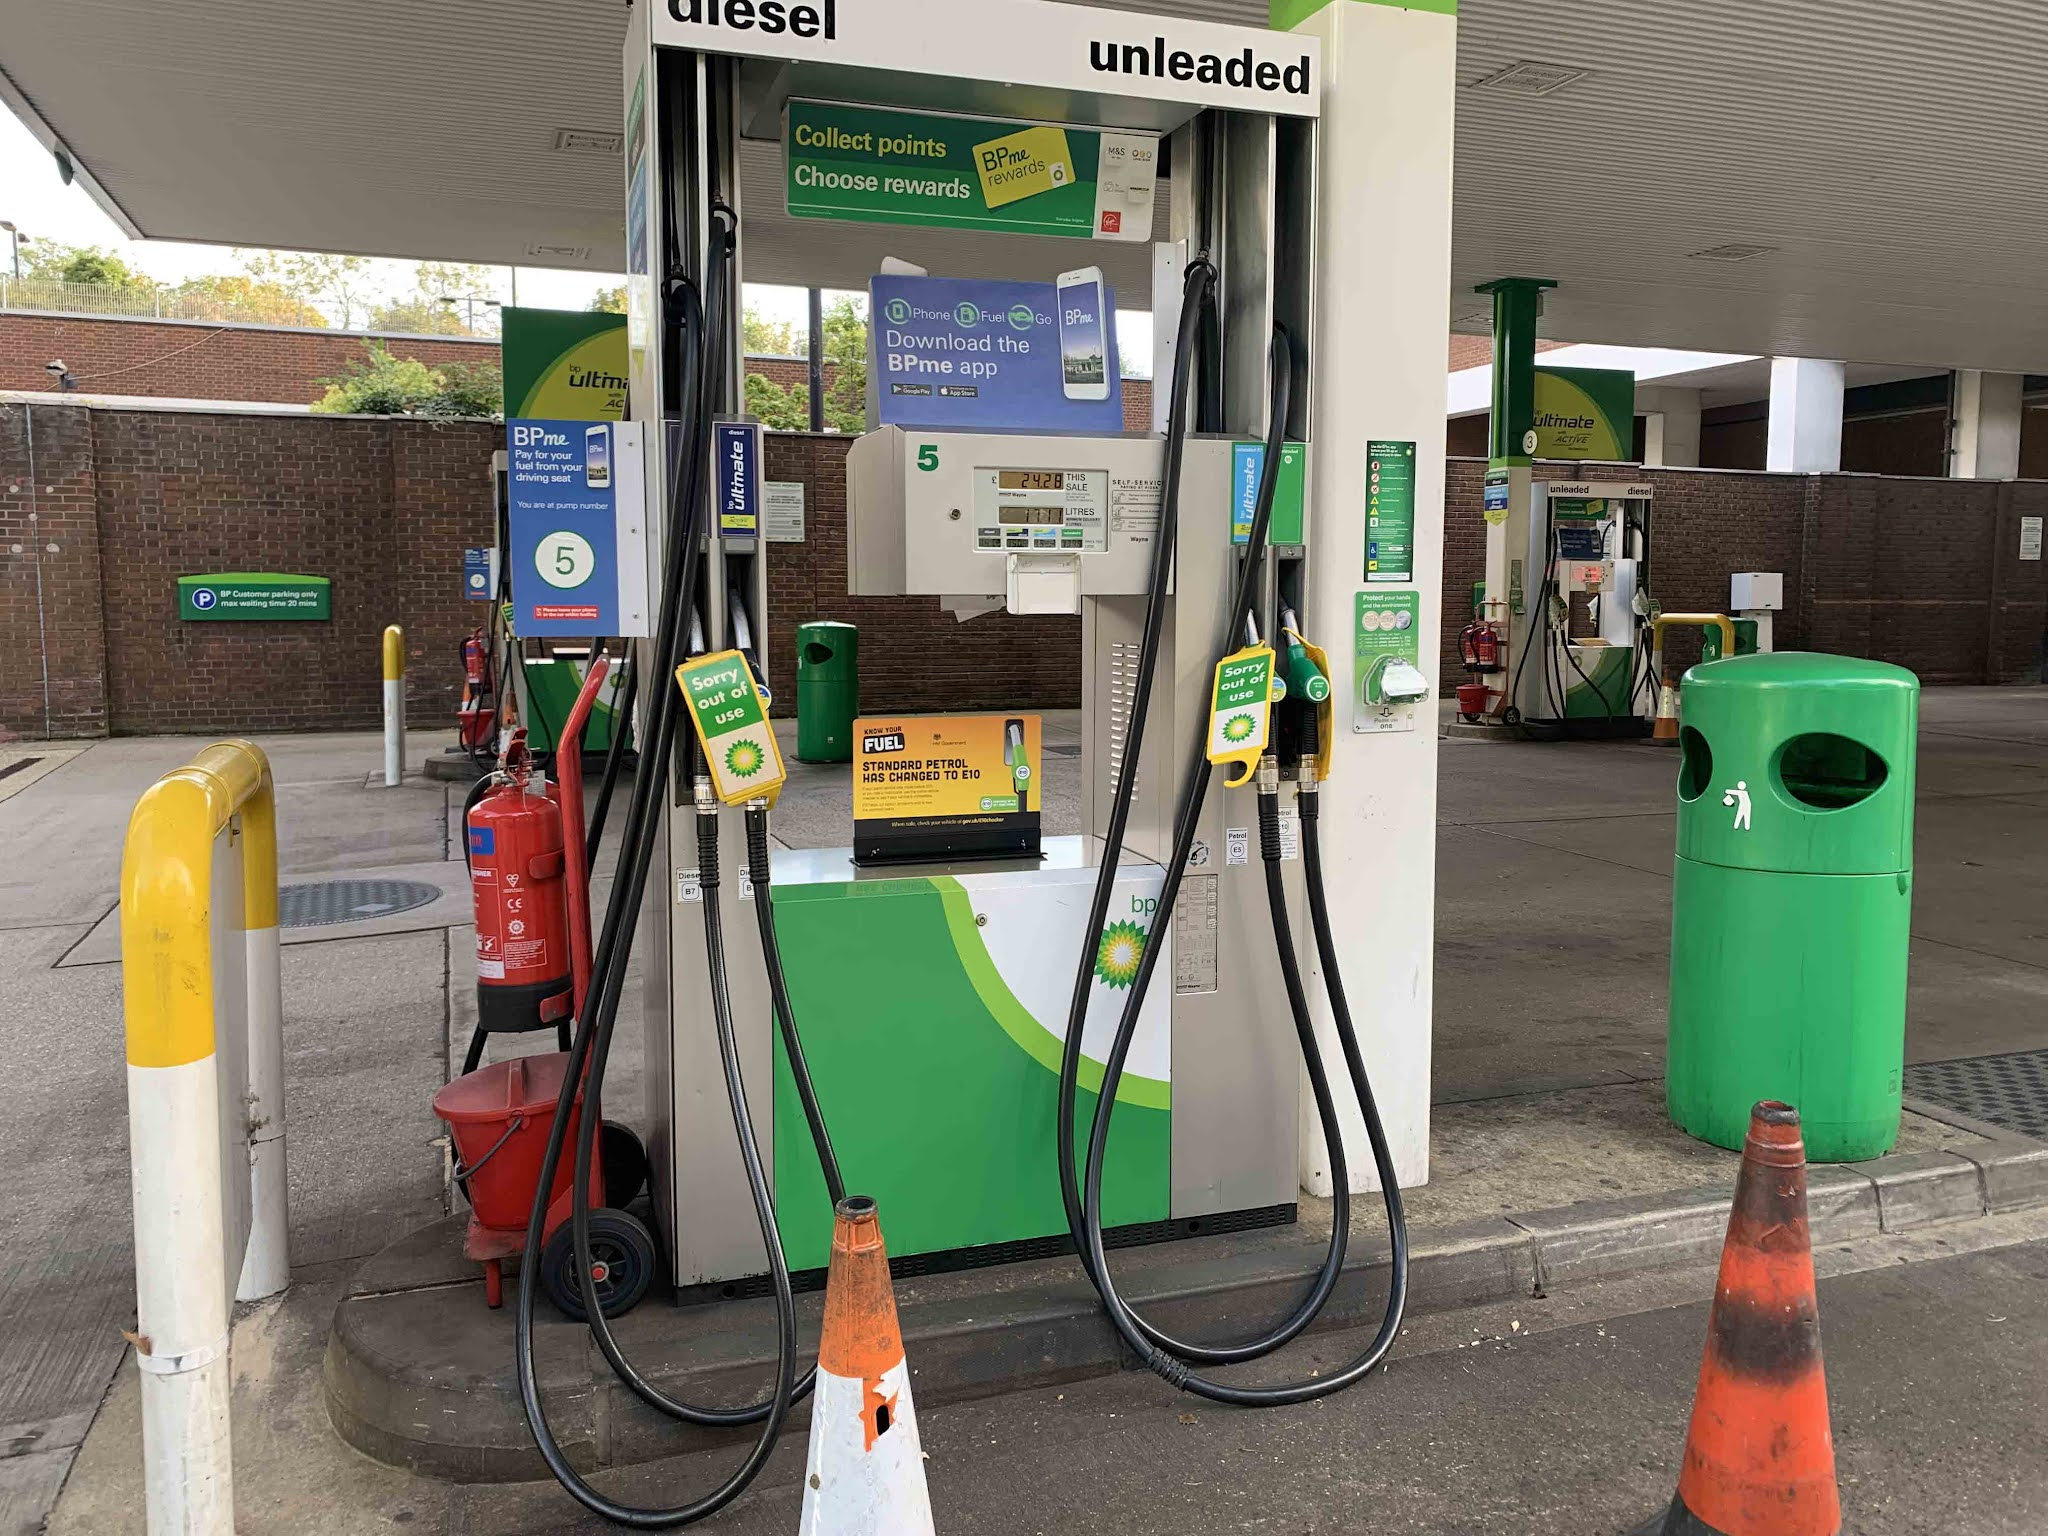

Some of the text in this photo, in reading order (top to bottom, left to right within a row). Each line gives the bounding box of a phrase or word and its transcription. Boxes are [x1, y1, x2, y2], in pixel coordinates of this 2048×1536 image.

[668, 0, 836, 40] diesel
[1090, 36, 1310, 95] unleaded
[795, 124, 947, 158] Collect points
[981, 147, 1030, 171] BPme
[795, 164, 971, 199] Choose rewards
[988, 159, 1046, 187] rewards
[912, 308, 1052, 325] Phone Fuel Go
[1065, 309, 1094, 326] BPme
[886, 330, 1030, 354] Download the
[887, 353, 998, 379] BPme app
[1533, 413, 1595, 429] ultimate
[513, 426, 570, 447] BPme
[1527, 436, 1534, 449] 3
[1555, 435, 1589, 444] ACTIVE
[515, 450, 573, 461] Pay for your
[917, 444, 939, 472] 5
[515, 461, 583, 473] fuel from your
[515, 472, 572, 484] driving seat
[730, 441, 745, 511] ultimate
[991, 476, 997, 484] £
[1066, 473, 1086, 481] THIS
[1066, 483, 1088, 491] SALE
[1243, 457, 1255, 519] ultimate
[1550, 485, 1652, 496] unleaded diesel
[517, 501, 532, 509] You
[556, 503, 579, 511] pump
[580, 502, 609, 510] number
[727, 500, 735, 510] bp
[1065, 507, 1095, 516] LITRES
[555, 546, 575, 575] 5
[220, 590, 318, 599] BP Customer parking only
[239, 600, 268, 609] waiting
[1224, 661, 1265, 678] Sorry
[691, 668, 738, 691] Sorry
[1221, 672, 1266, 691] out of
[698, 681, 748, 710] out of
[1228, 690, 1255, 702] use
[715, 707, 745, 725] use
[864, 727, 883, 735] KNOW
[864, 735, 904, 752] FUEL
[862, 758, 968, 772] STANDARD PETROL
[863, 769, 981, 783] HAS CHANGED TO E10
[1228, 832, 1247, 840] Petrol
[678, 872, 700, 880] Diese
[1131, 894, 1157, 917] bp
